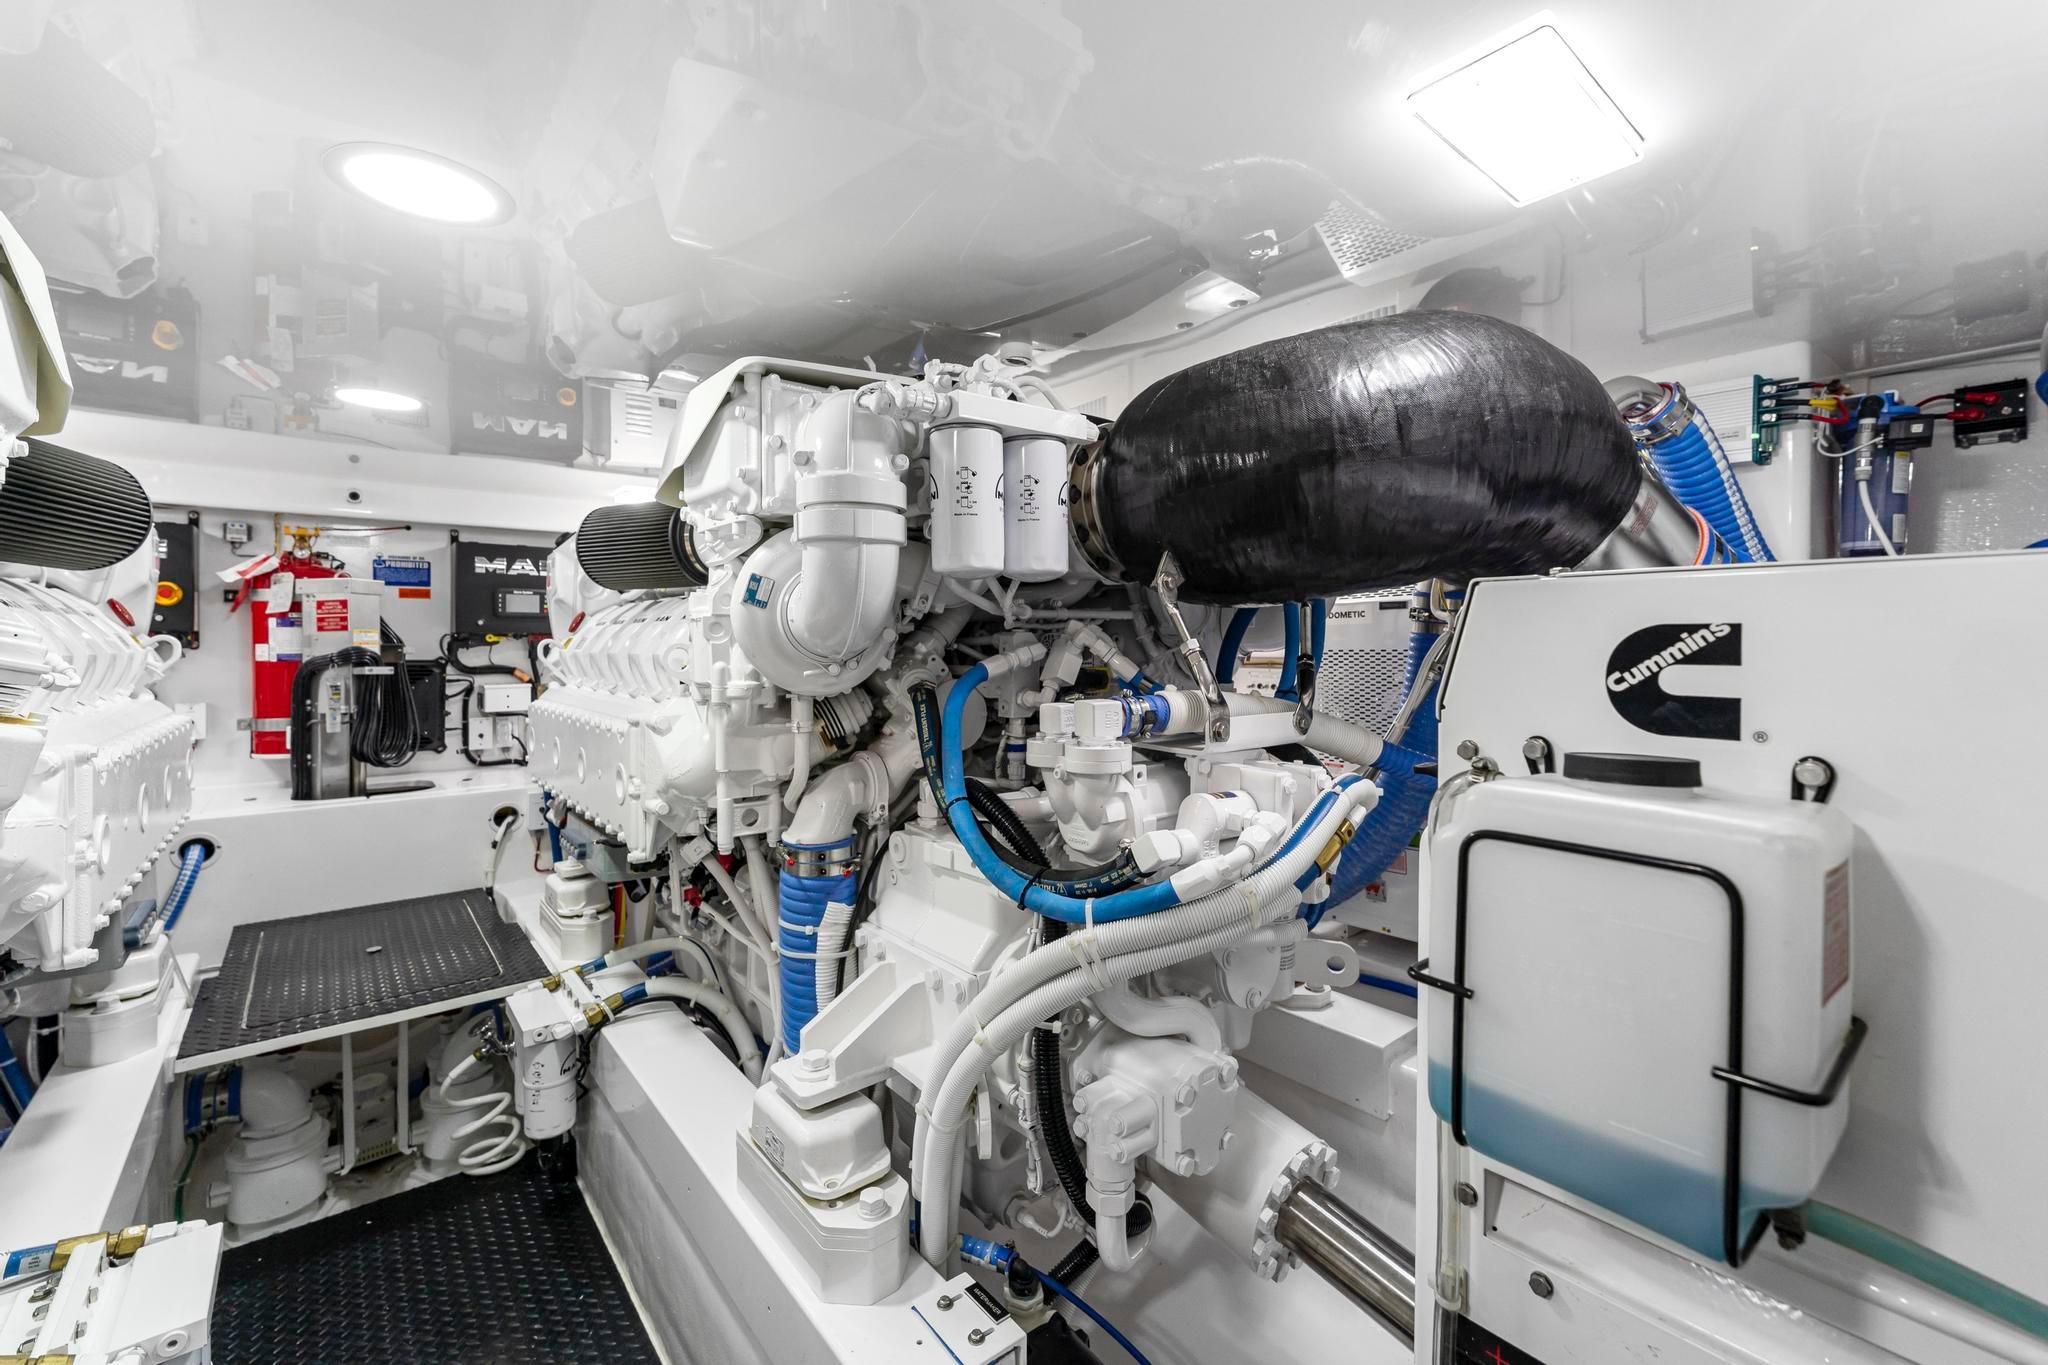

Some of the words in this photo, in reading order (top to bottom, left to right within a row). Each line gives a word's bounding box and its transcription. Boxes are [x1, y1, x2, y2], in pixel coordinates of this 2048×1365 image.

[474, 556, 548, 577] MA
[1328, 610, 1366, 619] DOMETIC
[1606, 621, 1732, 692] Cummins
[973, 1287, 1002, 1315] WATERMAKER
